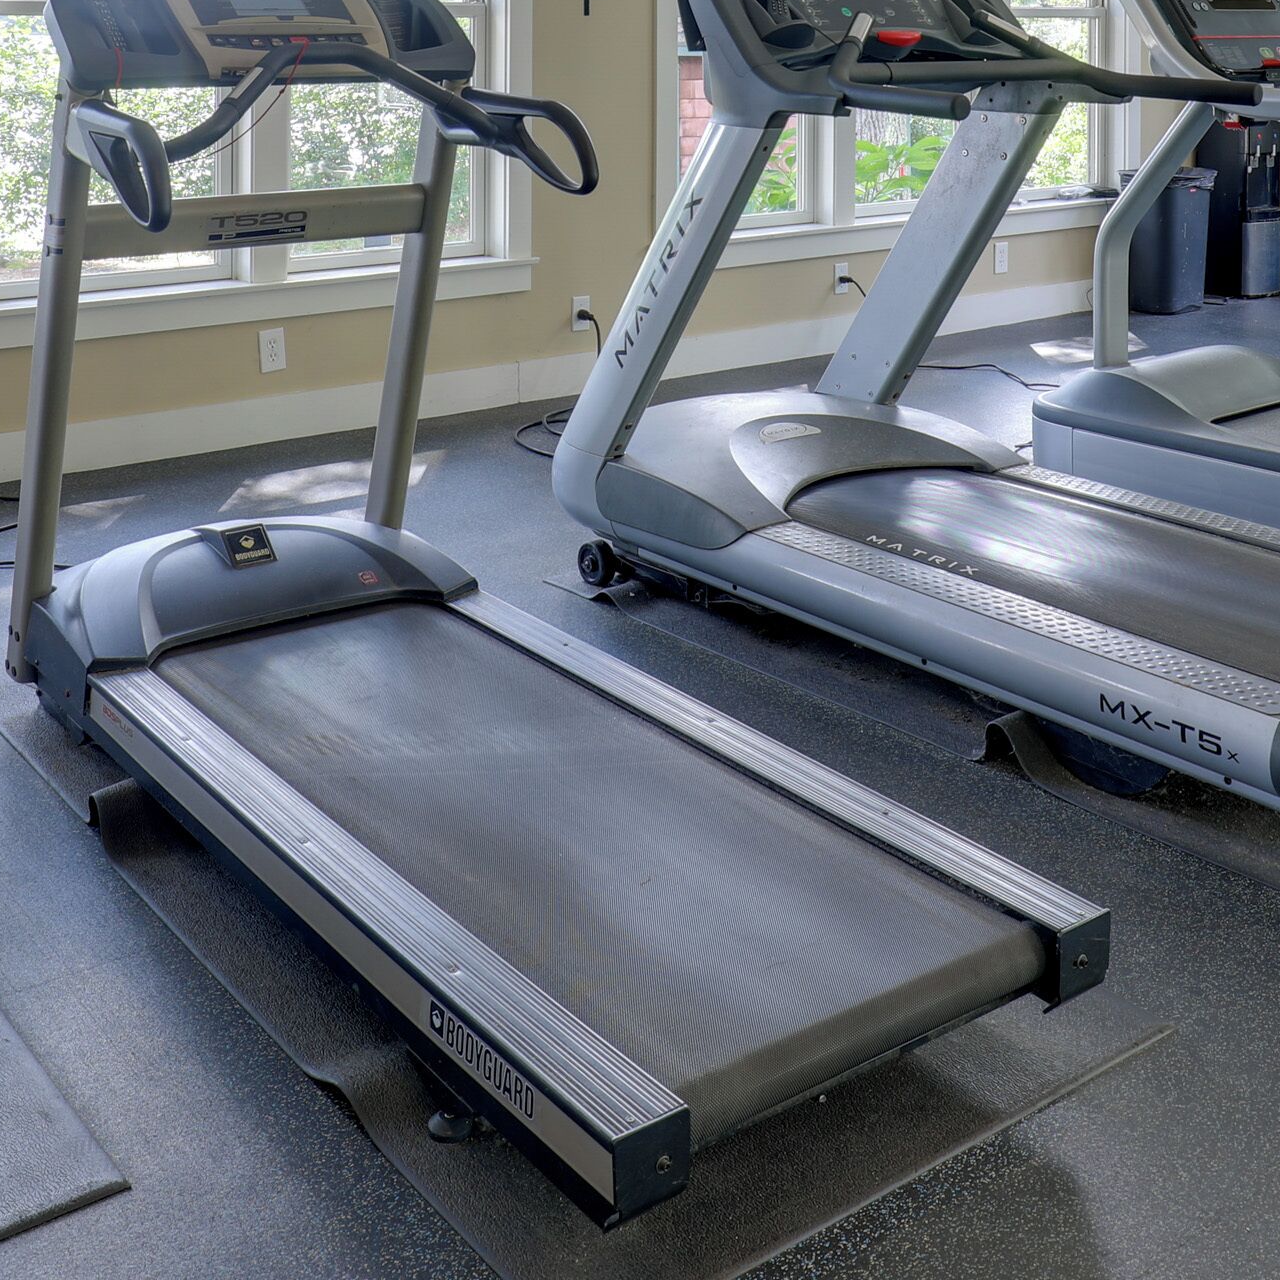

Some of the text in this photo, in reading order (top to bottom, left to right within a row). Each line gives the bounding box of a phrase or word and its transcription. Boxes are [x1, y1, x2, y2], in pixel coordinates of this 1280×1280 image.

[211, 210, 308, 229] T520
[615, 191, 704, 369] MATRIX
[235, 548, 270, 561] BODYGUARD
[866, 534, 979, 576] MATRIX
[446, 1015, 535, 1119] BODYGUARD
